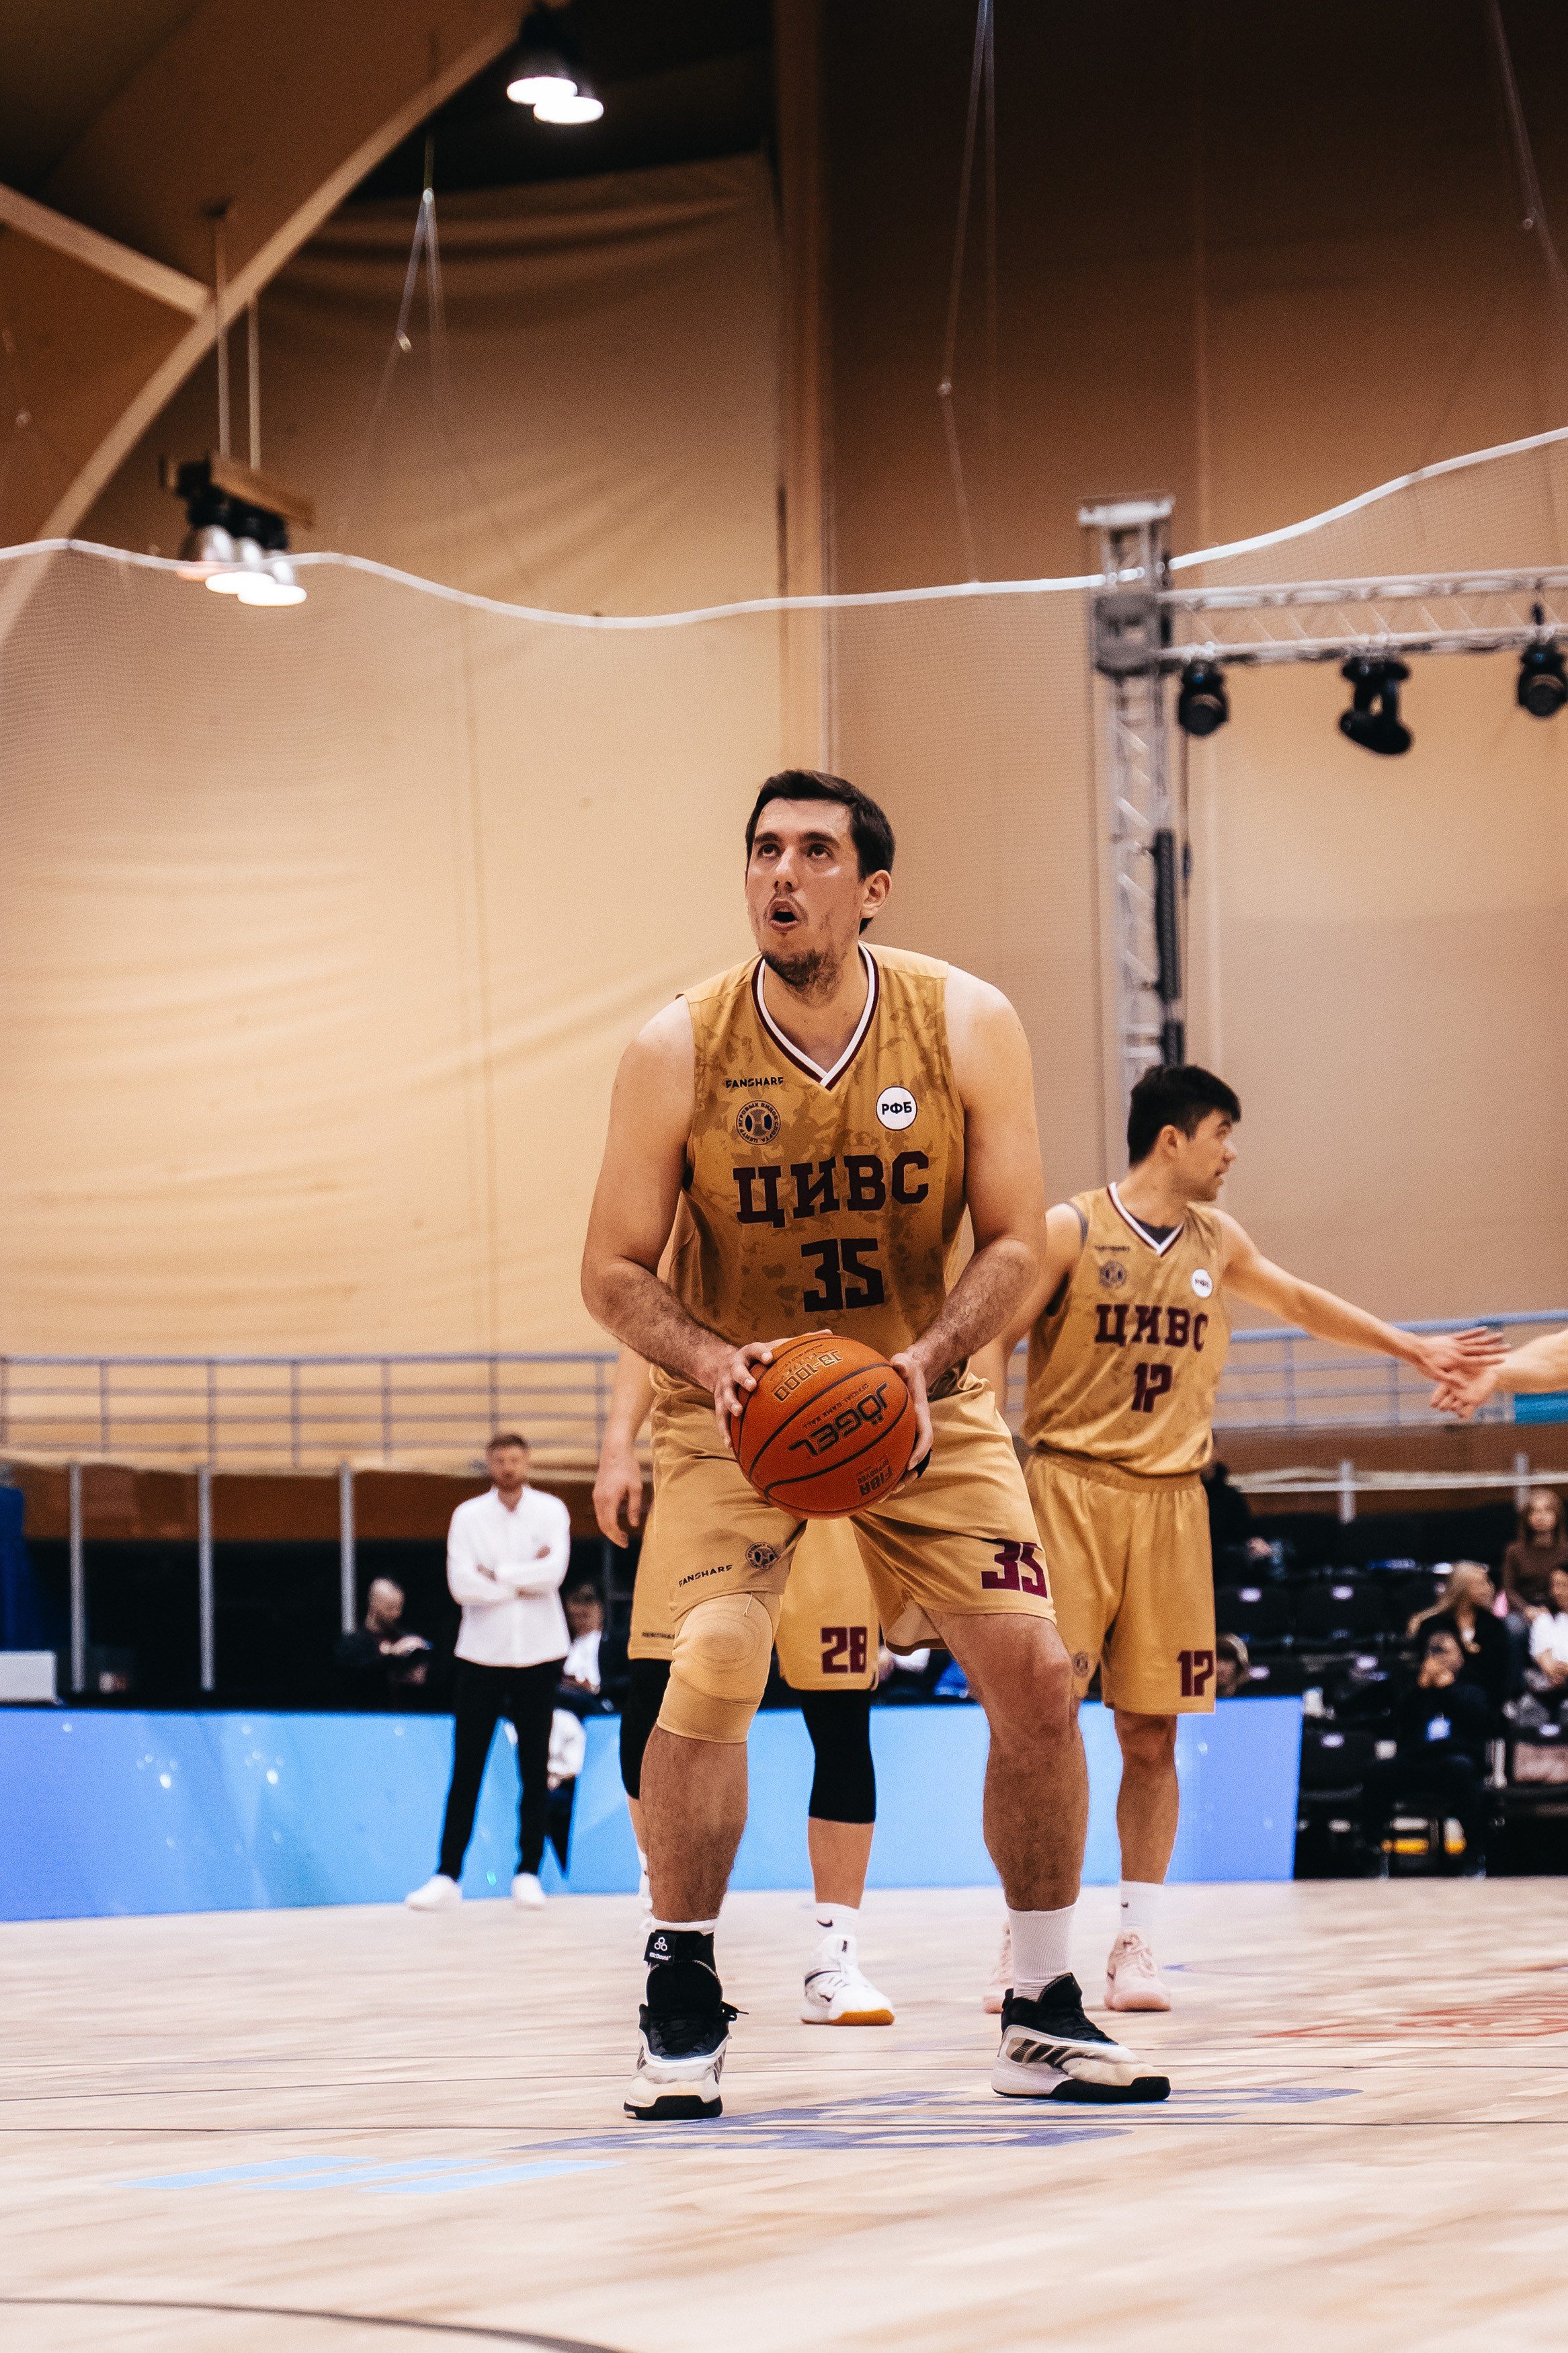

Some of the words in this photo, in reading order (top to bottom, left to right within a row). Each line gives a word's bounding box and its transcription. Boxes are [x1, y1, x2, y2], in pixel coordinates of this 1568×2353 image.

[881, 1101, 912, 1115] РФБ
[733, 1150, 929, 1228] ЦИВС
[800, 1238, 885, 1312] 35
[1095, 1303, 1208, 1352] ЦИВС
[774, 1350, 842, 1402] JB-1000
[788, 1382, 888, 1456] JÖGEL
[802, 1414, 823, 1429] BALL
[860, 1465, 893, 1496] FIBA
[981, 1541, 1048, 1599] 35
[821, 1627, 868, 1674] 28
